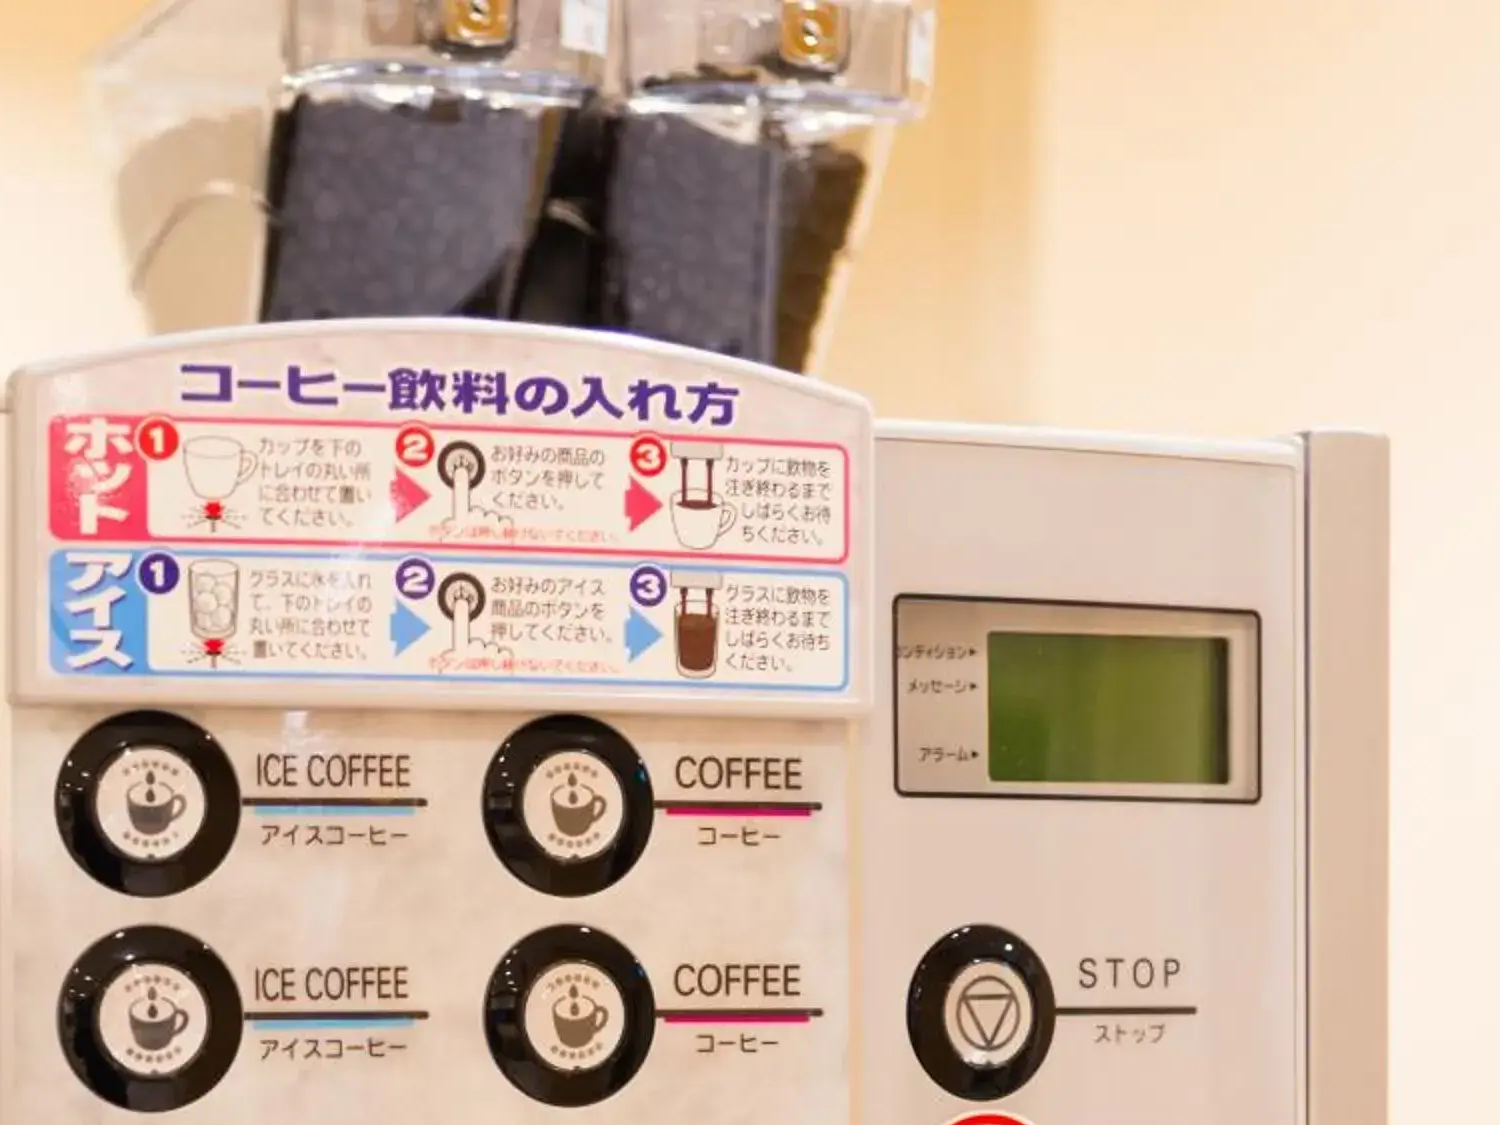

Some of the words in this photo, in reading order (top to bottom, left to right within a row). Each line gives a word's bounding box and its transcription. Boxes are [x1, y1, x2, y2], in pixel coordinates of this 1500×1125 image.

[180, 364, 740, 426] コーヒー飲料の入れ方
[258, 437, 362, 458] カップを下の
[490, 444, 605, 466] お好みの商品の
[64, 418, 134, 534] ホット
[725, 455, 831, 478] カップに飲物を
[490, 468, 604, 490] ボタンを押して
[725, 478, 833, 501] 注ぎ終わるまで
[492, 491, 565, 511] ください。
[259, 507, 355, 528] てください。
[740, 502, 832, 525] しばらくお待
[741, 526, 824, 546] ちください。
[490, 576, 605, 596] お好みのアイス
[725, 584, 831, 606] グラスに飲物を
[64, 552, 134, 671] アイス
[490, 599, 605, 619] 商品のボタンを
[725, 606, 832, 628] 注ぎ終わるまで
[490, 622, 613, 643] 押してください。
[725, 630, 831, 651] しばらくお待ち
[725, 653, 795, 673] ください。
[917, 747, 970, 762] アラーム
[256, 753, 298, 787] ICE
[307, 753, 411, 788] COFFEE
[674, 755, 804, 790] COFFEE
[260, 824, 409, 846] アイスコーヒー
[697, 826, 781, 846] コーヒー
[254, 967, 296, 1001] ICE
[305, 966, 409, 1001] COFFEE
[673, 963, 802, 997] COFFEE
[1077, 957, 1182, 989] STOP
[695, 1033, 780, 1054] コーヒー
[1094, 1024, 1167, 1045] ストップ
[259, 1038, 407, 1061] アイスコーヒー
